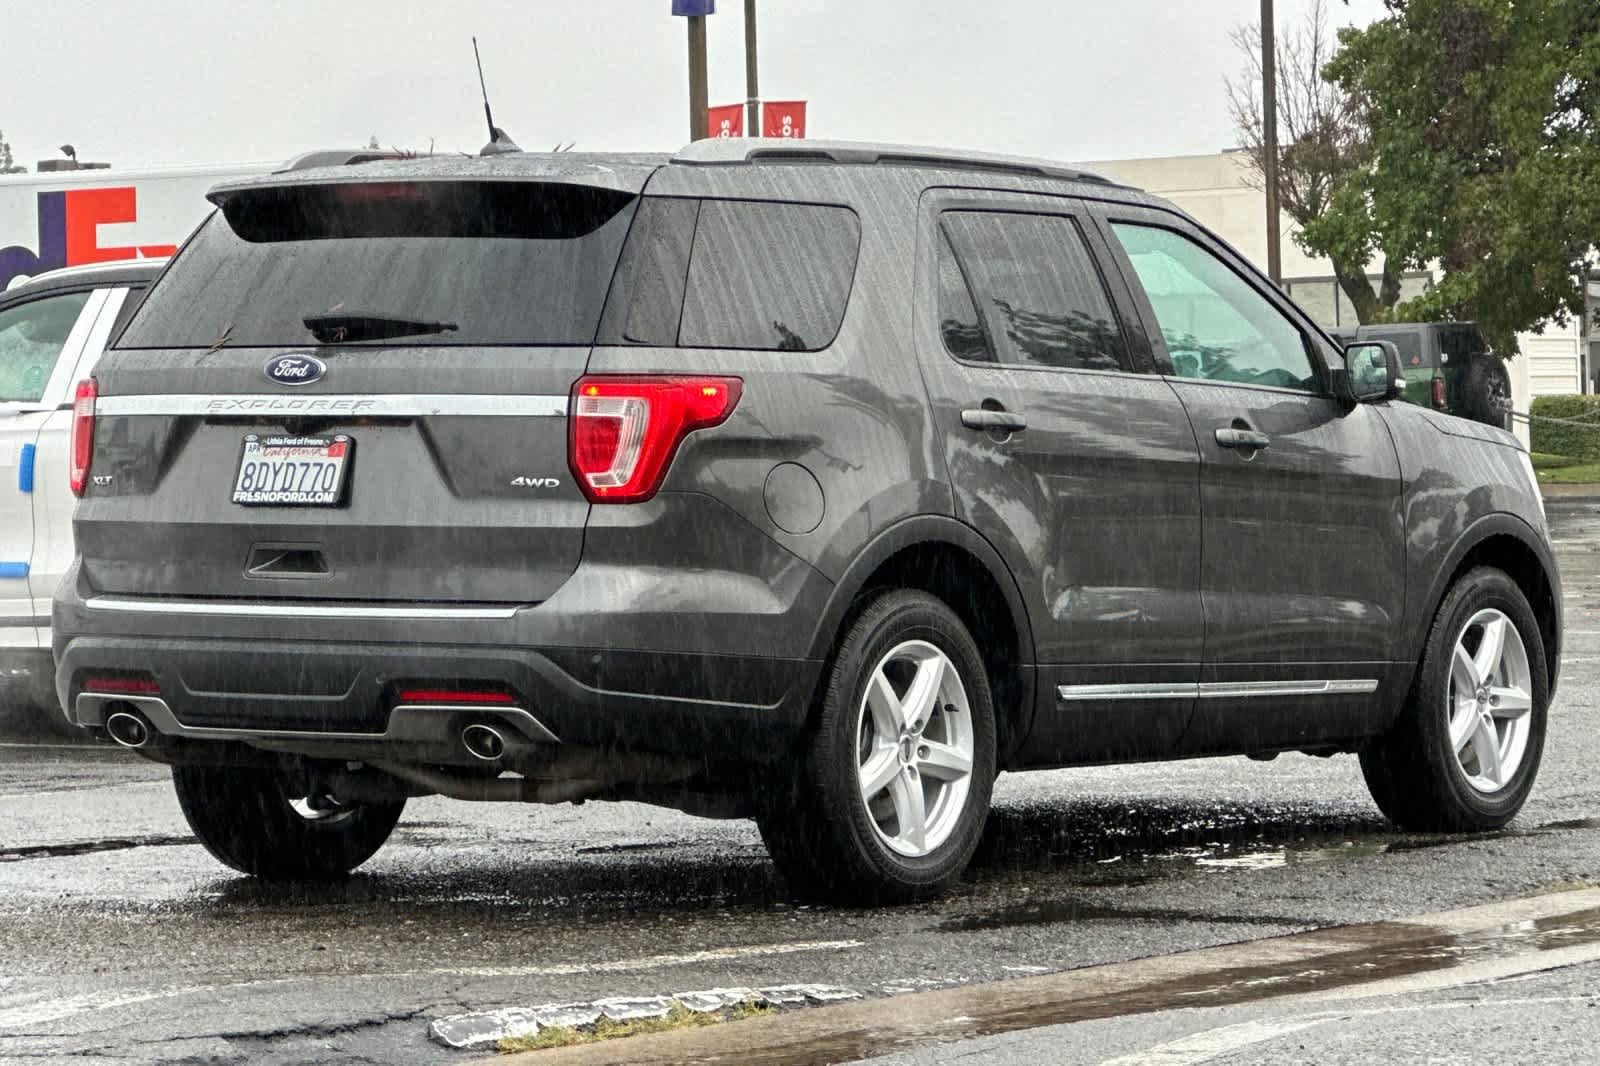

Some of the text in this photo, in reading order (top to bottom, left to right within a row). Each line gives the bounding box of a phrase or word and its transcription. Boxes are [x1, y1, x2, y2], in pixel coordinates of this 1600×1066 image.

[274, 359, 309, 377] Ford
[206, 399, 377, 410] EXPLORER
[241, 462, 336, 491] 8DYD770
[510, 476, 560, 488] 4WD
